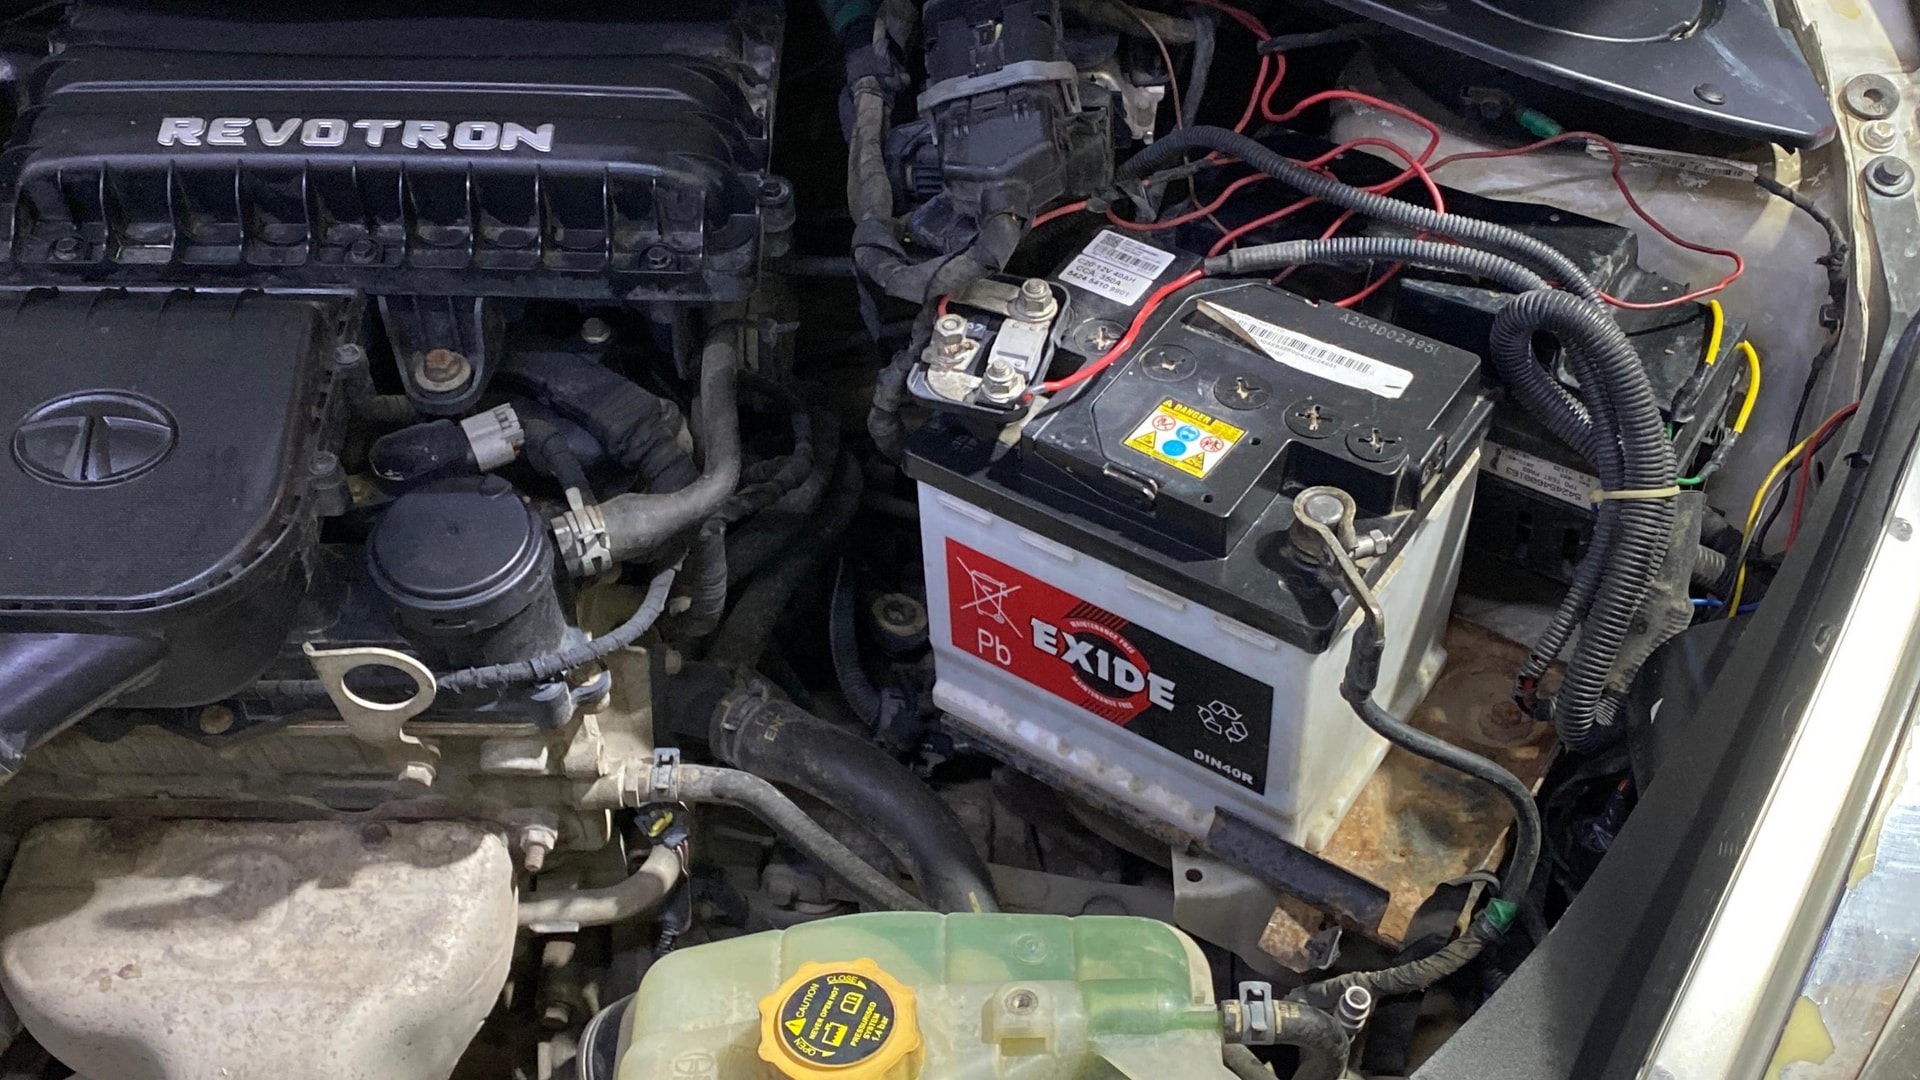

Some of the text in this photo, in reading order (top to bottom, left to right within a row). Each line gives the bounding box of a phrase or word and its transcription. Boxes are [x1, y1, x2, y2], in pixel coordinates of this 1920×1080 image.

[157, 117, 555, 152] REVOTRON
[1096, 264, 1113, 274] 12V
[1113, 271, 1136, 283] 40AH
[1101, 273, 1121, 286] 350A
[1174, 403, 1212, 425] DANGER
[977, 627, 1011, 665] Pb
[1069, 620, 1135, 654] MAINTENANCE FREE
[1031, 617, 1176, 712] EXIDE
[1071, 675, 1134, 710] MAINTENANCE FREE
[1194, 749, 1253, 785] DIN40R
[827, 975, 858, 984] CLOSE
[796, 983, 819, 1018] CAUTION
[809, 986, 840, 1040] NEVER OPEN HOT
[850, 1002, 877, 1047] PRESSURISED
[863, 1013, 880, 1040] SYSTEM
[879, 1016, 889, 1030] bar
[793, 1037, 816, 1056] OPEN
